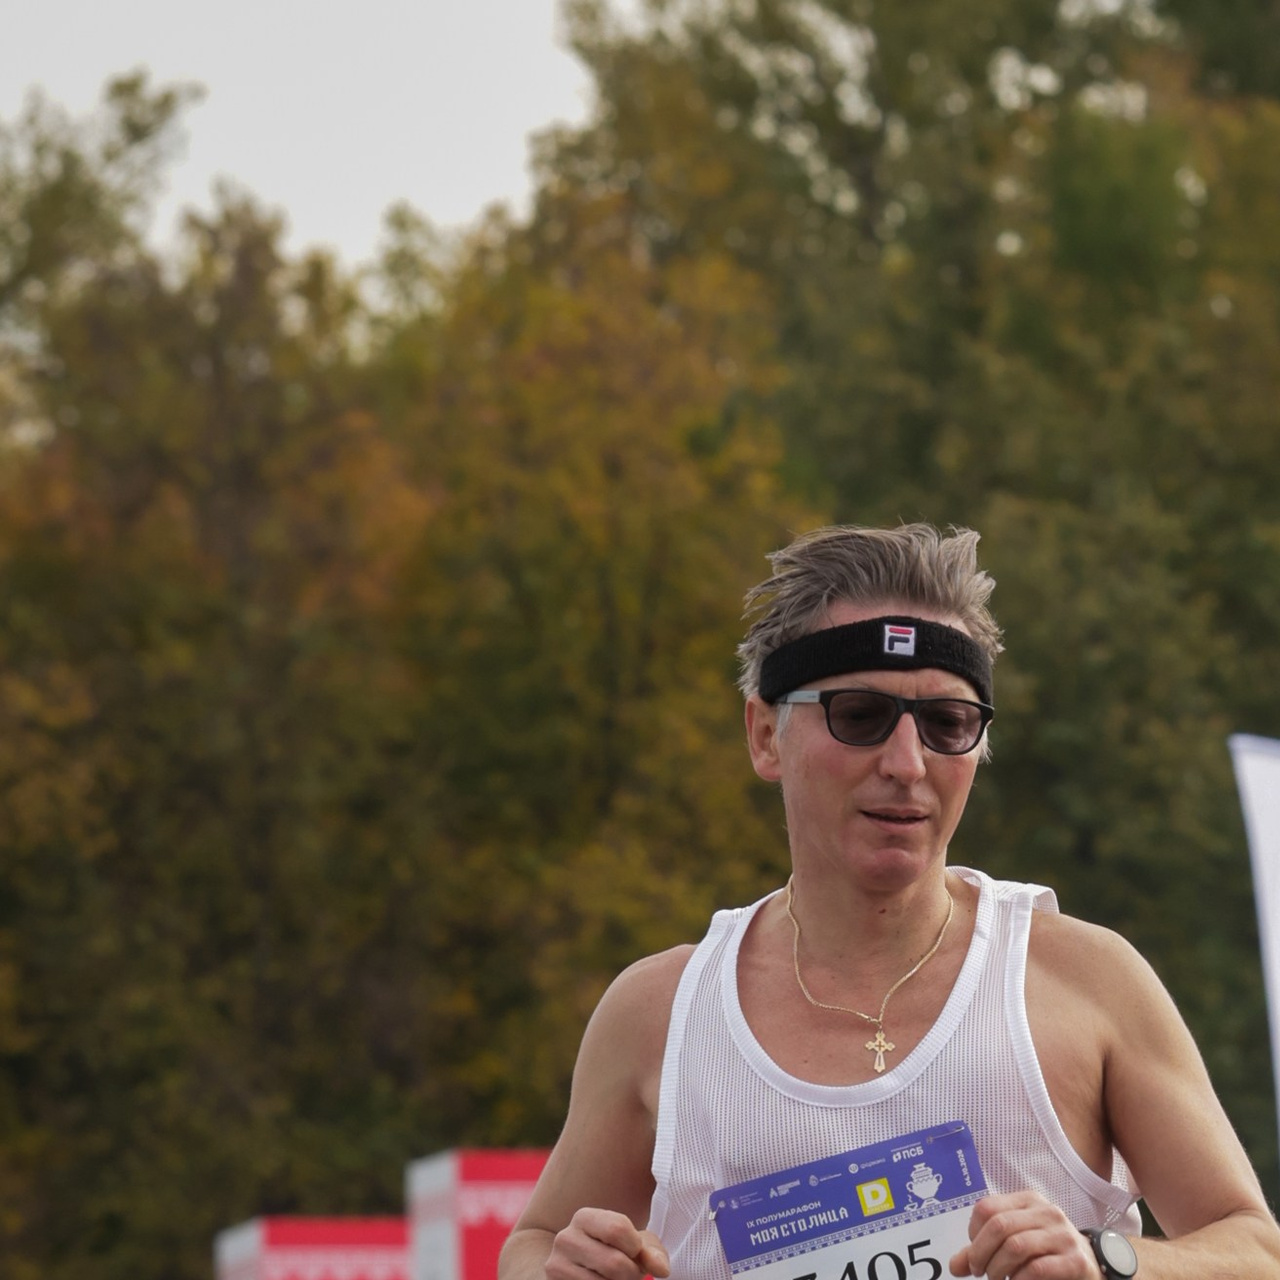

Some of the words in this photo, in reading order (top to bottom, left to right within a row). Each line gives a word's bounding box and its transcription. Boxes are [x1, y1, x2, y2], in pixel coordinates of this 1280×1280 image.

[902, 1146, 924, 1160] ПСБ
[750, 1226, 779, 1246] МОЯ
[780, 1206, 849, 1238] СТОЛИЦА
[755, 1201, 821, 1226] ПОЛУМАРАФОН
